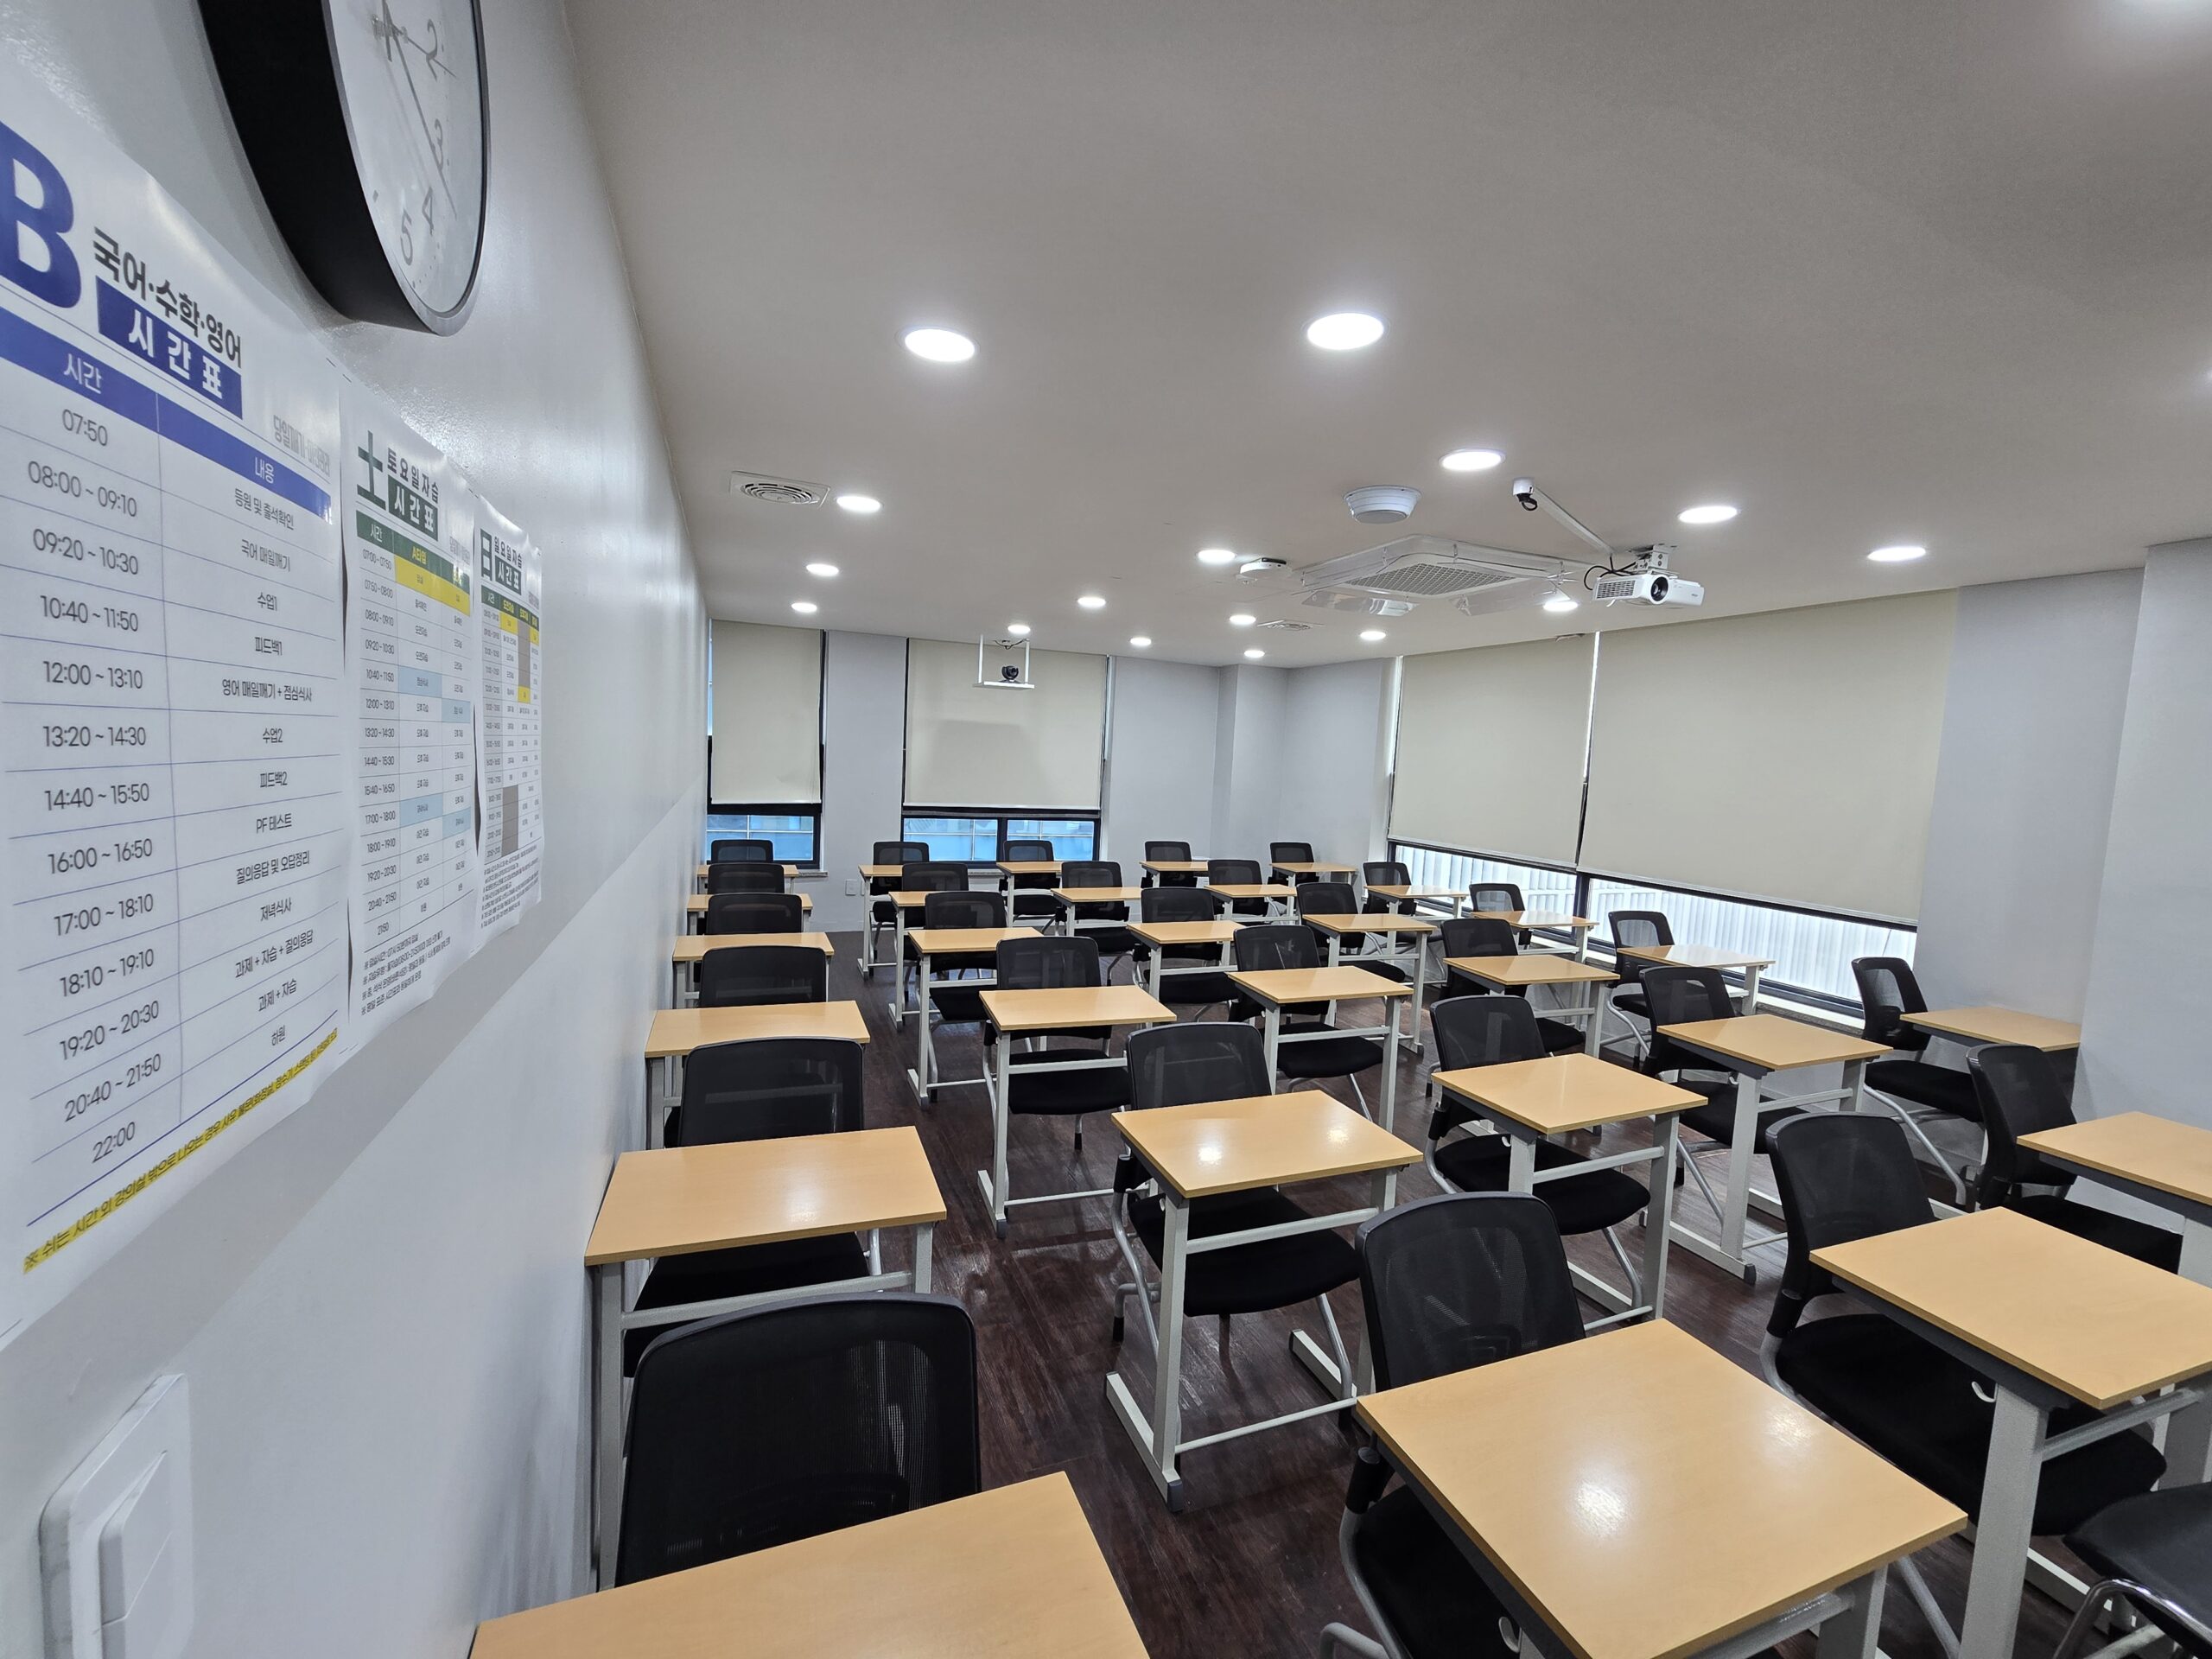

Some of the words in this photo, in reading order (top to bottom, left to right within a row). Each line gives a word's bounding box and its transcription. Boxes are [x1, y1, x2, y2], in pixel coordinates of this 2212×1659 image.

[426, 19, 437, 81] 2
[433, 118, 443, 171] 3
[0, 120, 82, 308] B
[422, 187, 435, 235] 4
[400, 208, 413, 265] 5
[64, 353, 102, 395] 시간
[62, 409, 108, 446] 07:50
[255, 457, 274, 483] 내용
[356, 430, 386, 511] 土
[28, 461, 81, 497] 08:00
[98, 486, 137, 517] 09:10
[234, 488, 251, 511] 등원
[253, 498, 262, 515] 및
[241, 539, 257, 560] 국어
[370, 524, 383, 543] 시간
[33, 529, 84, 561] 09:20
[100, 547, 138, 575] 10:30
[41, 595, 87, 624] 10:40
[104, 607, 138, 632] 11:50
[254, 637, 283, 655] 피드백1
[42, 661, 91, 685] 12:00
[108, 667, 143, 690] 13:10
[222, 678, 240, 697] 영어
[283, 685, 312, 702] 점심식사
[42, 726, 91, 747] 13:20
[108, 727, 146, 747] 14:30
[263, 728, 283, 744] 수업2
[45, 787, 93, 810] 14:40
[111, 783, 149, 804] 15:50
[260, 772, 288, 788] 피드백2
[256, 818, 268, 834] PF
[269, 813, 292, 830] 테스트
[48, 847, 98, 874] 16:00
[114, 838, 152, 862] 16:50
[236, 861, 269, 885] 질의응답
[270, 859, 279, 875] 및
[281, 850, 310, 871] 오답정리
[54, 907, 101, 936] 17:00
[118, 893, 154, 919] 18:10
[260, 897, 292, 921] 저녁식사
[60, 965, 103, 997] 18:10
[119, 949, 154, 976] 19:10
[235, 959, 253, 978] 과제
[261, 946, 277, 966] 자습
[258, 989, 274, 1012] 과제
[282, 977, 297, 998] 자습
[60, 1025, 105, 1060] 19:20
[121, 1001, 159, 1034] 20:30
[270, 1025, 286, 1046] 하원
[65, 1081, 111, 1122] 20:40
[127, 1053, 162, 1088] 21:50
[92, 1122, 136, 1164] 22:00
[42, 1229, 70, 1256] 쉬는
[73, 1209, 99, 1234] 시간
[100, 1197, 112, 1217] 외
[115, 1173, 146, 1208] 강의실
[147, 1152, 177, 1184] 밖으로
[177, 1135, 204, 1162] 나오는
[204, 1121, 221, 1142] 경우
